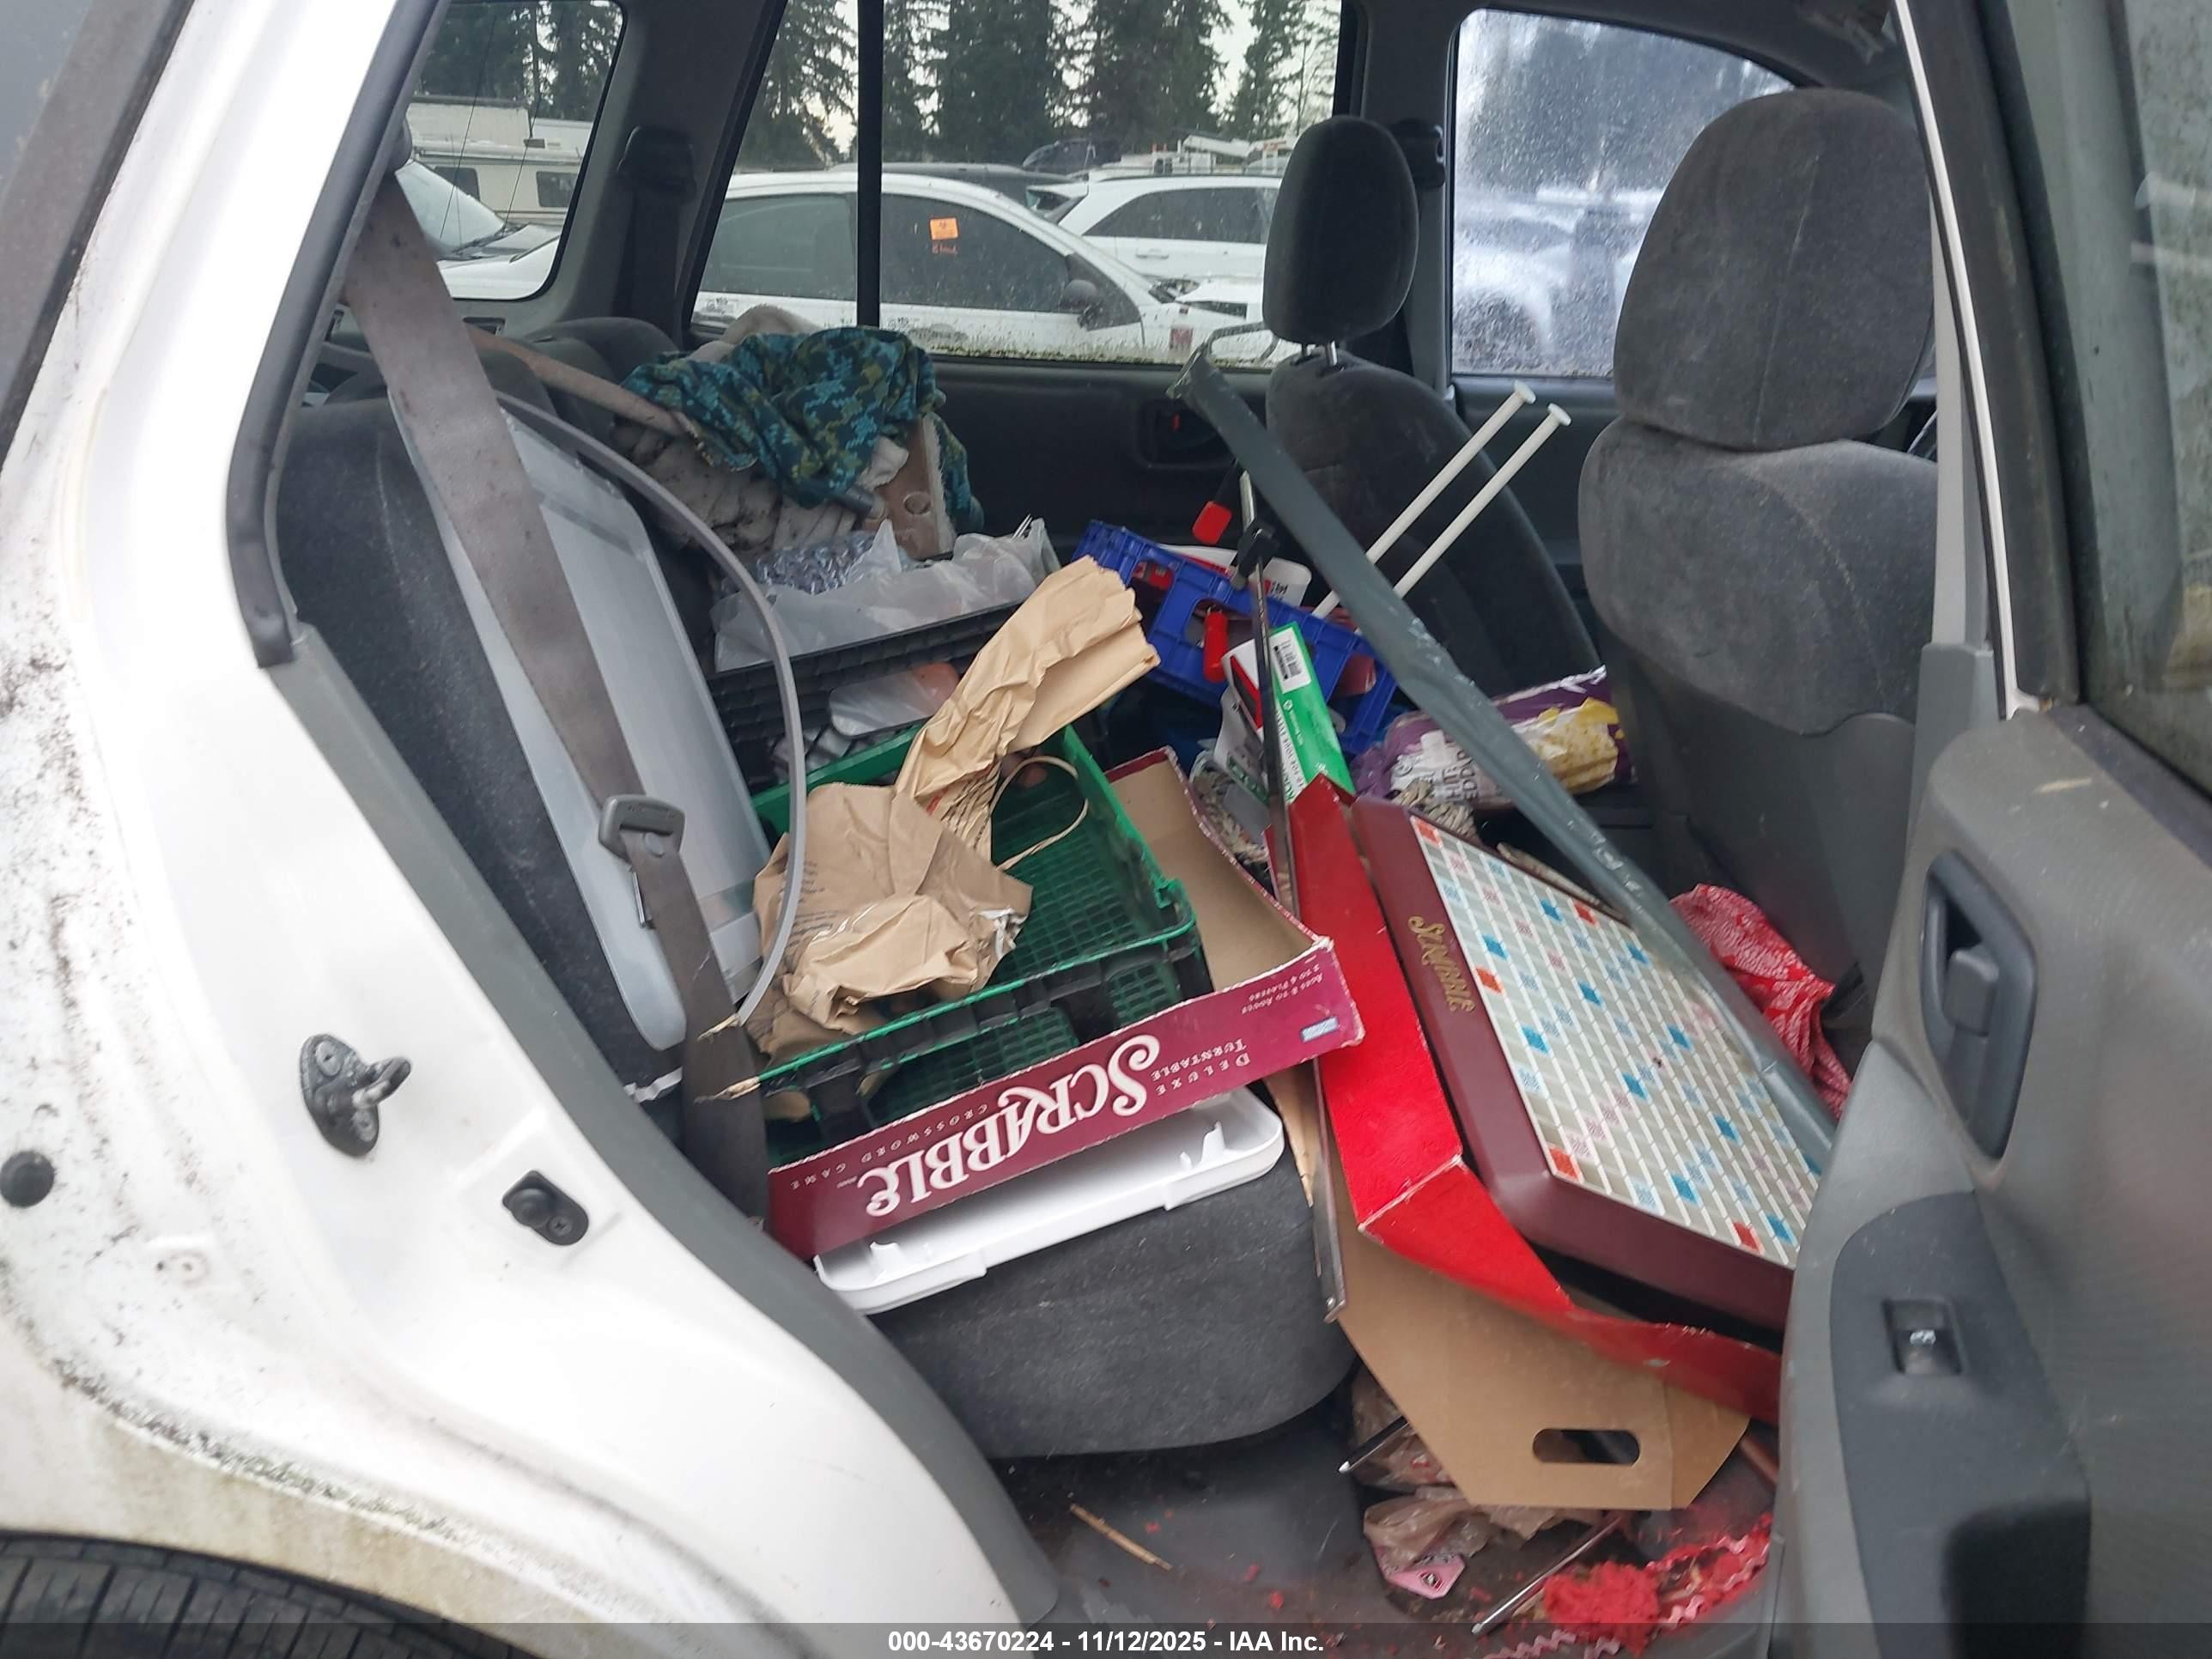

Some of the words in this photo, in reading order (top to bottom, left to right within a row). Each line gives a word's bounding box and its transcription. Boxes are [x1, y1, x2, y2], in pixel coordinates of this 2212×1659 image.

[1151, 1038, 1247, 1082] TURNTABLE
[1156, 1052, 1251, 1097] DELUXE
[857, 1034, 1160, 1217] SCRABBLE
[861, 1103, 988, 1164] CROSSWORD
[790, 1163, 847, 1190] GAME
